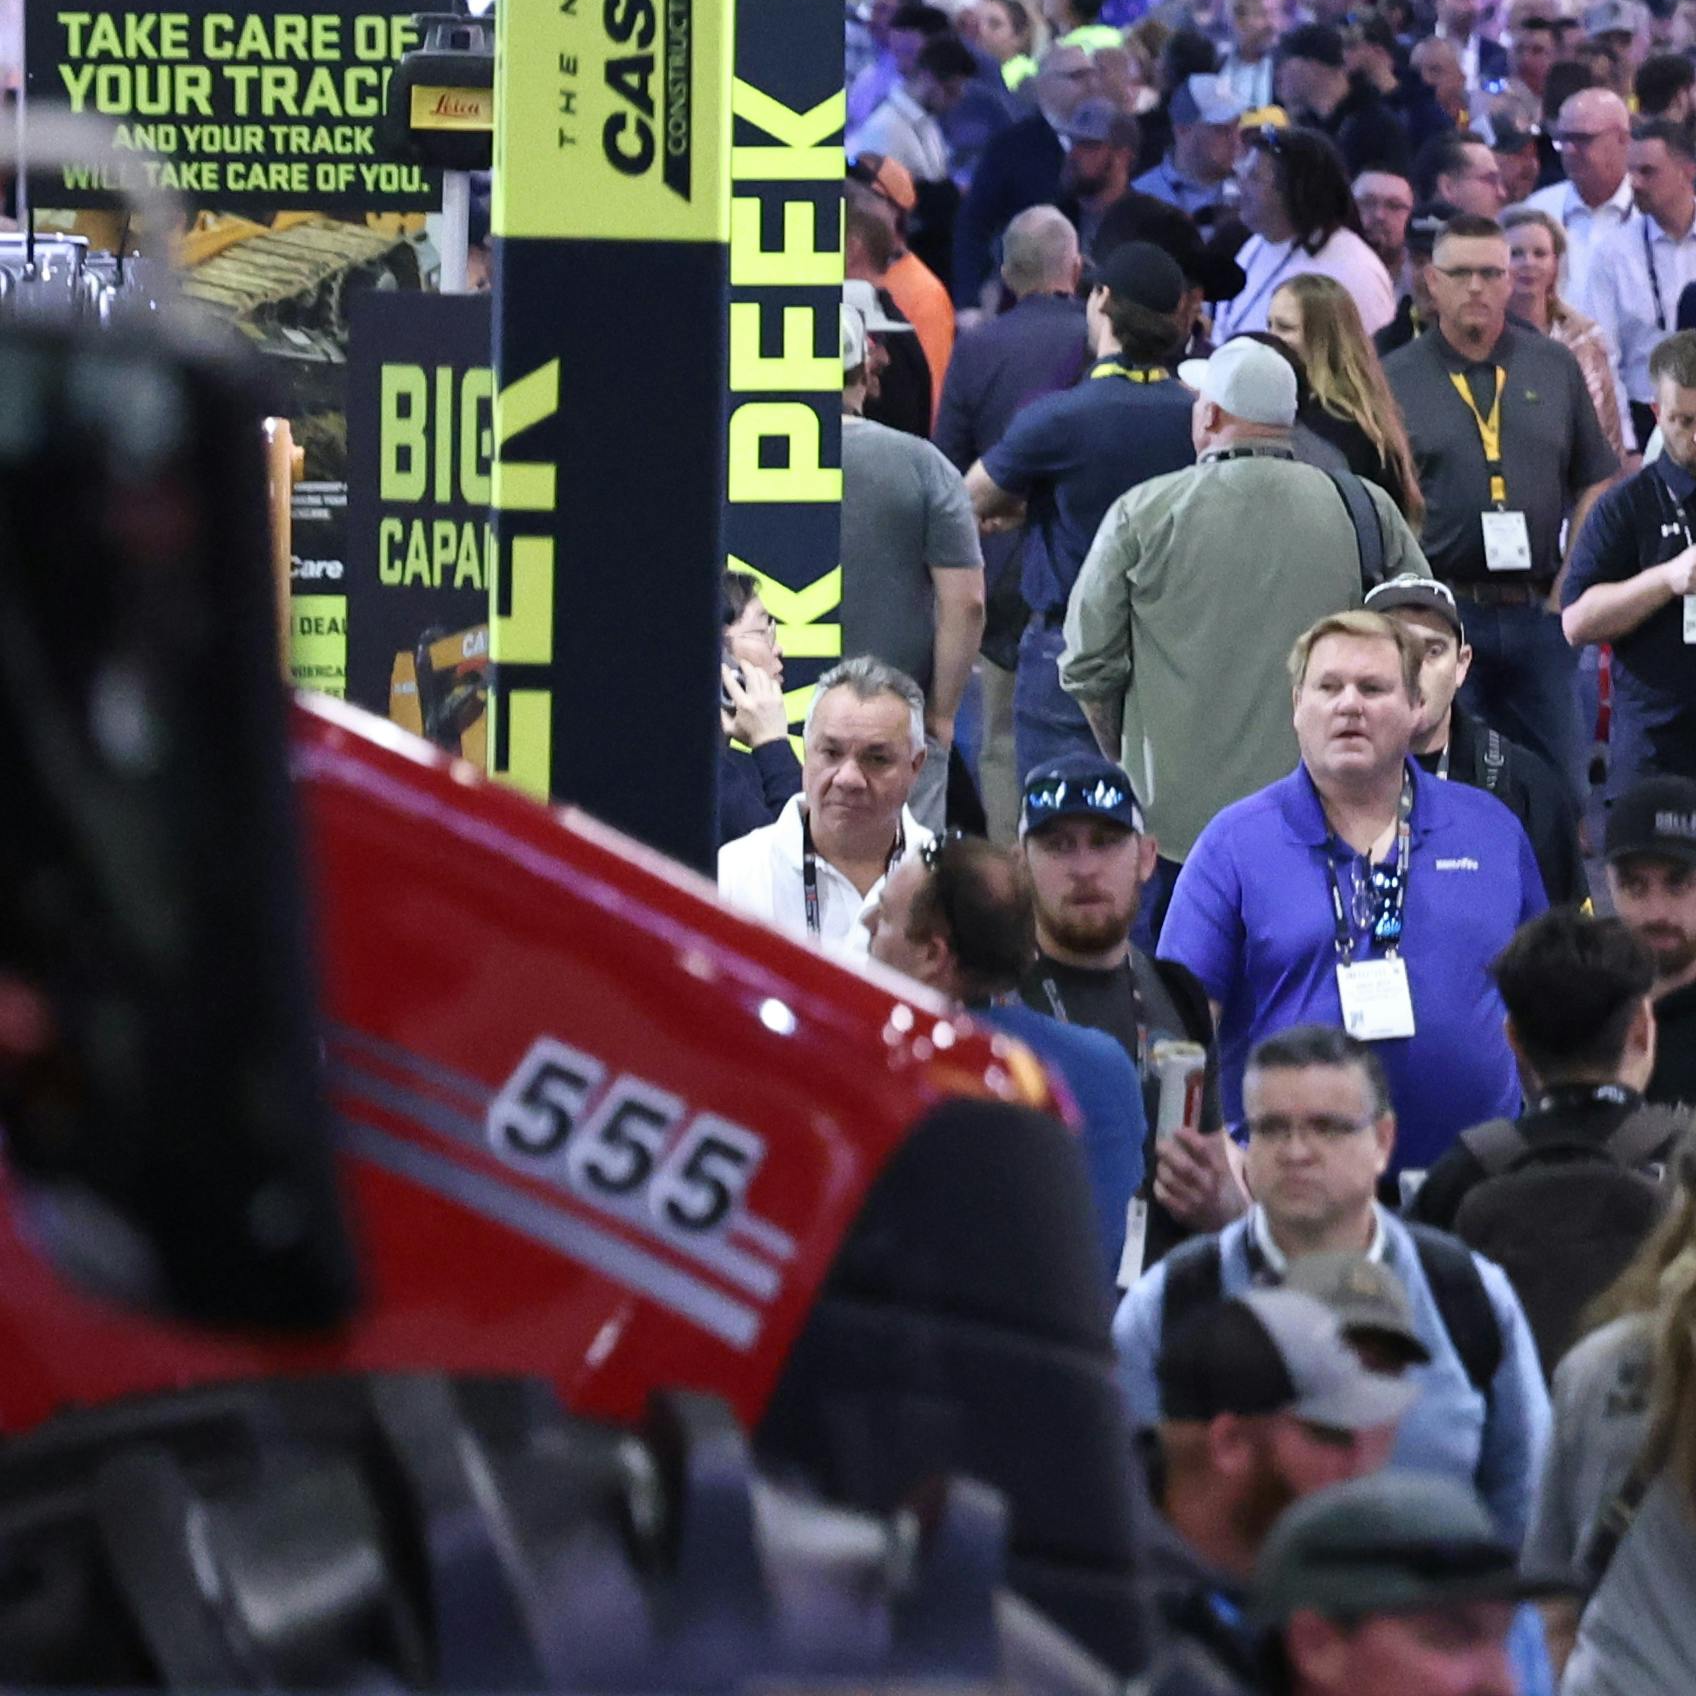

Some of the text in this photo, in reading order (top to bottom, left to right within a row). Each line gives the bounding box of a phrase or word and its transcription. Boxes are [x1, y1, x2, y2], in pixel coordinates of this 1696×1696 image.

[57, 11, 190, 59] TAKE
[203, 13, 341, 61] CARE
[58, 64, 213, 116] YOUR
[429, 96, 480, 117] Leica
[558, 53, 578, 149] THE
[112, 124, 374, 155] AND YOUR TRACK
[226, 163, 308, 191] CARE
[316, 163, 353, 192] OF
[360, 163, 429, 193] YOU.
[728, 76, 846, 502] PEEK
[494, 1050, 756, 1234] 555
